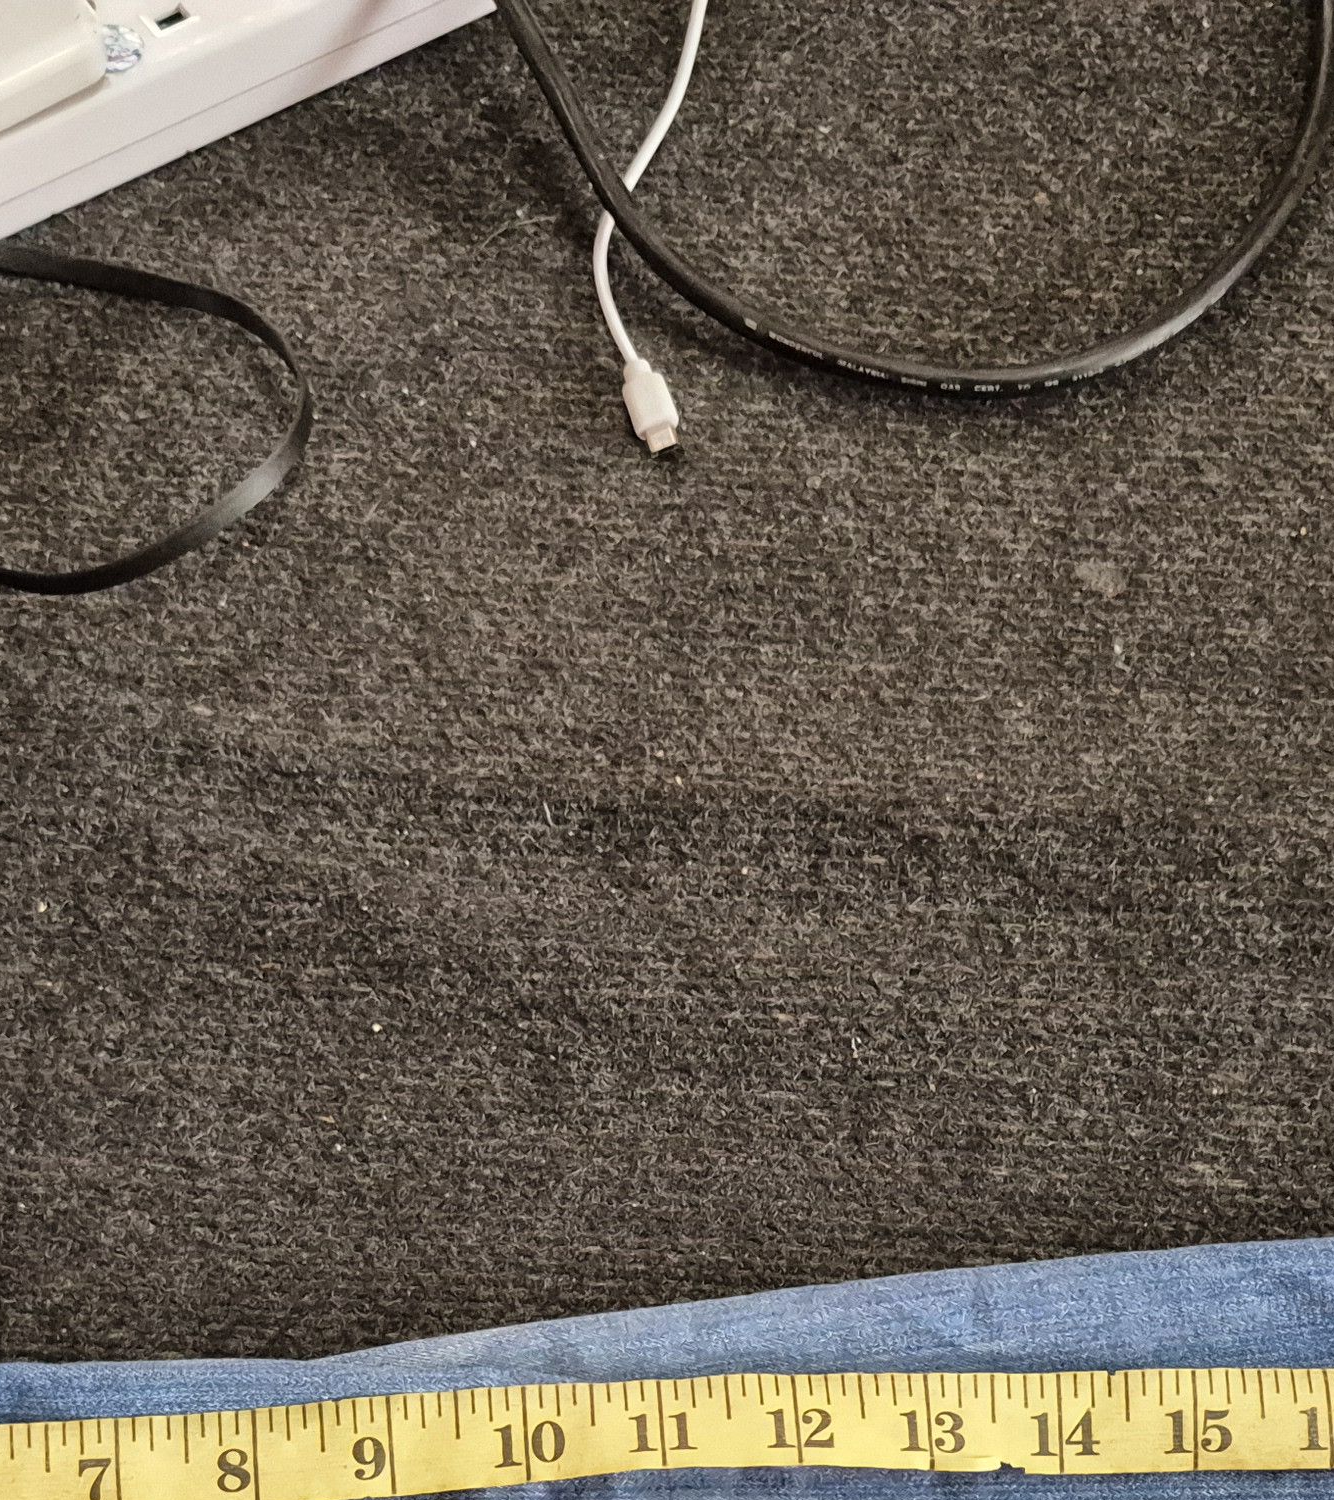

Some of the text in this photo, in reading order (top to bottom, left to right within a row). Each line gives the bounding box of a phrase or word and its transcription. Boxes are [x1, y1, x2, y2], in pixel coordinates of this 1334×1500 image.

[217, 1448, 251, 1493] 8
[352, 1436, 386, 1481] 9
[493, 1420, 566, 1469] 10
[628, 1412, 698, 1453] 11
[766, 1409, 835, 1449] 12
[899, 1410, 965, 1453] 13
[1030, 1408, 1100, 1456] 14
[1164, 1408, 1233, 1454] 15
